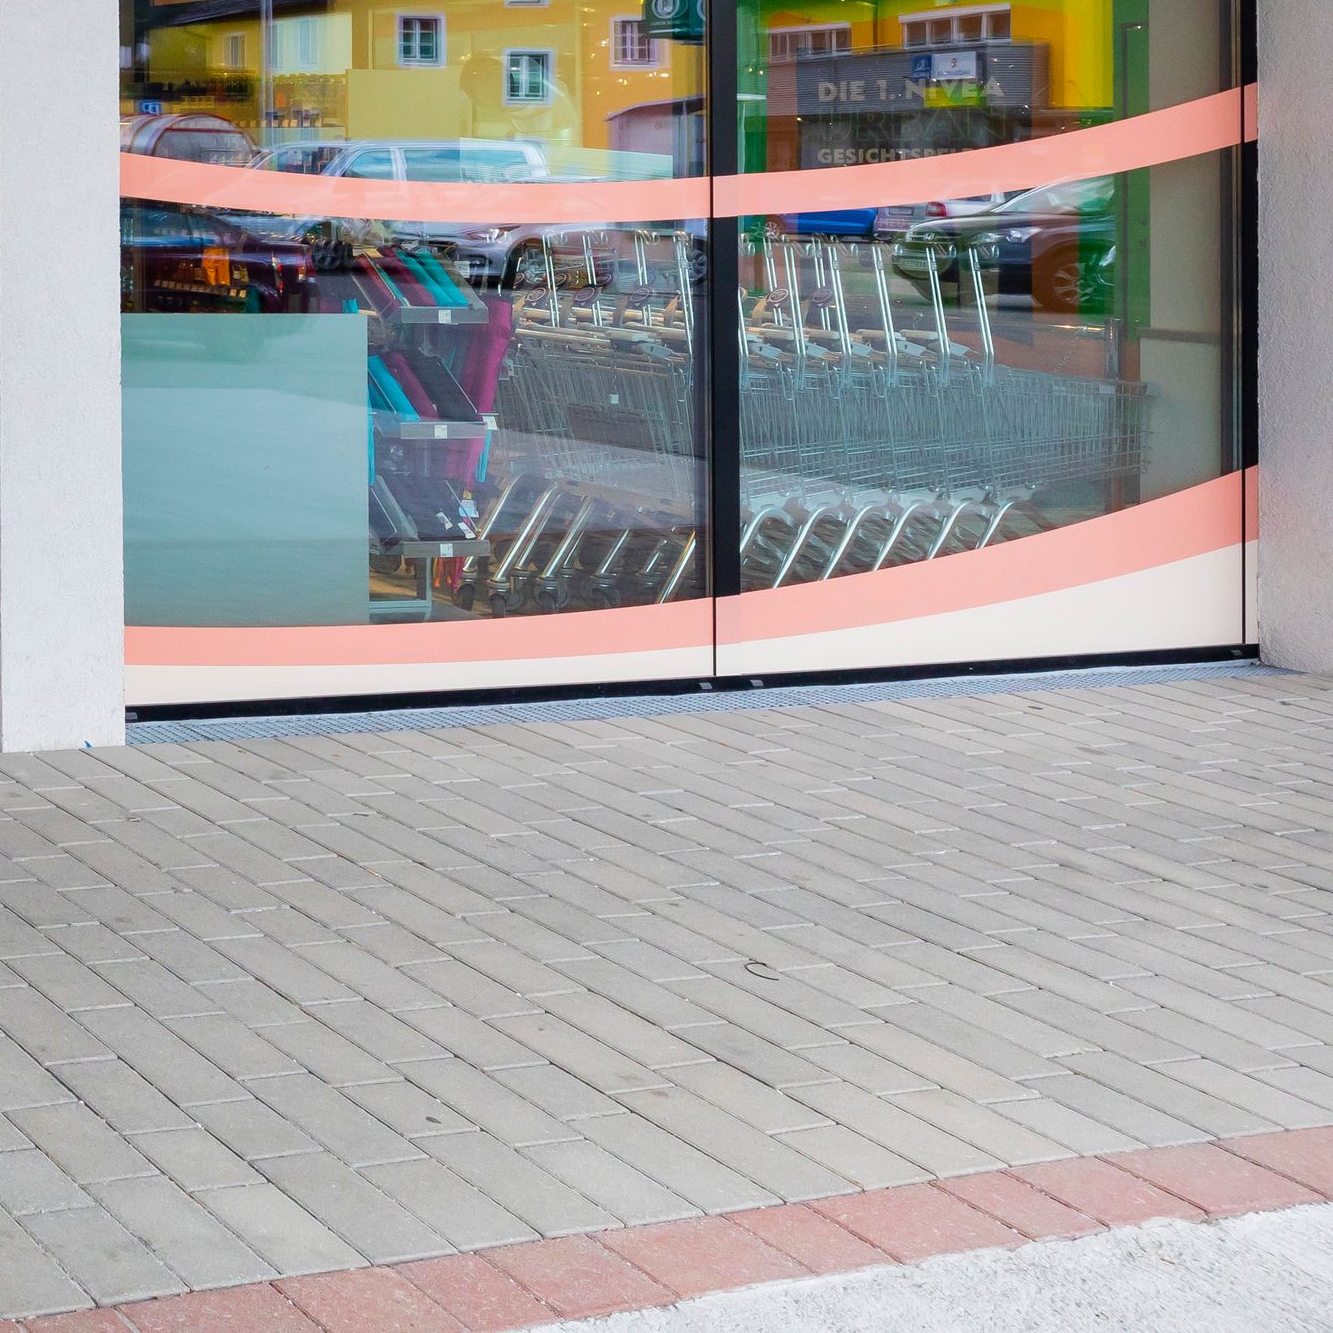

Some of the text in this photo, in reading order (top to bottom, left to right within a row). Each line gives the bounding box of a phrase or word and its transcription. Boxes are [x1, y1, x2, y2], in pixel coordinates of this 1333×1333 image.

[817, 76, 1006, 103] DIE 1. NIVEA
